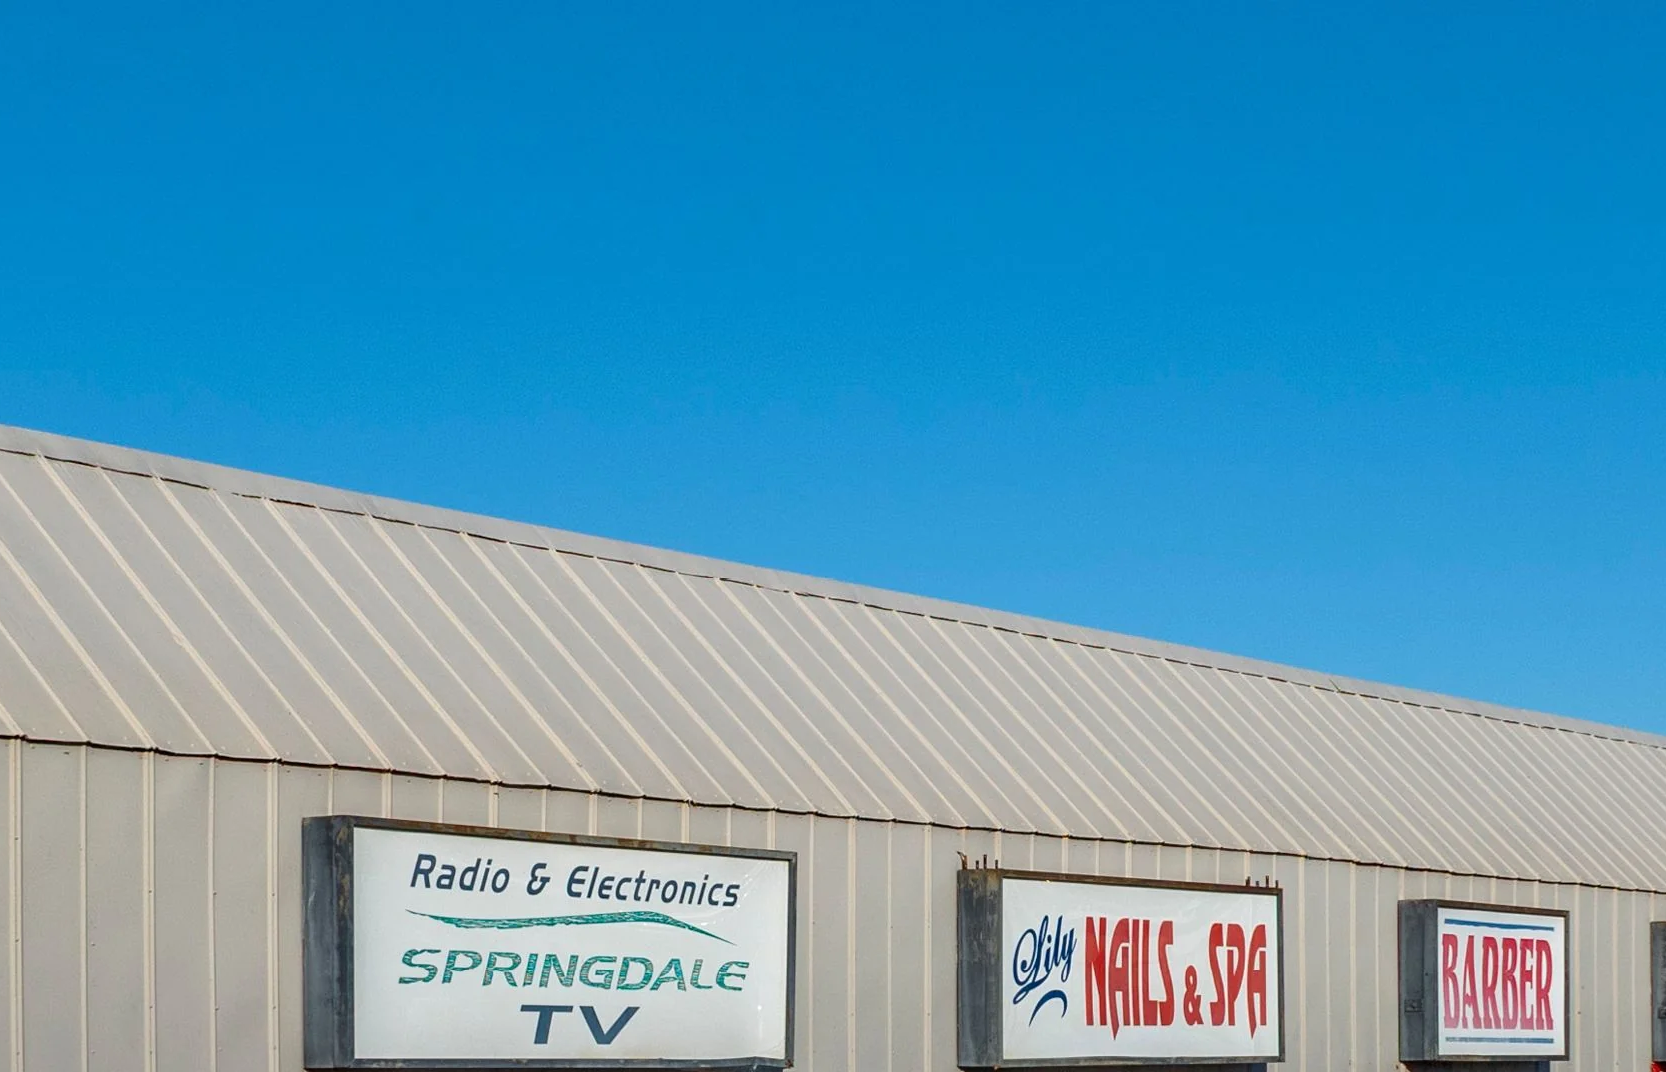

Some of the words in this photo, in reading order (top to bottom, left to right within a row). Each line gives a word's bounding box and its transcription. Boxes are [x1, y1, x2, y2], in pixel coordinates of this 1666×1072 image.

[410, 853, 510, 894] Radio
[525, 863, 551, 896] &
[567, 865, 740, 907] Electronics
[397, 947, 751, 992] SPRINGDALE
[1013, 914, 1078, 1005] Lily
[1085, 916, 1175, 1040] NAILS
[1183, 964, 1204, 1027] &
[1209, 922, 1268, 1039] SPA
[1441, 932, 1555, 1031] BARBER
[520, 1004, 641, 1046] TV
